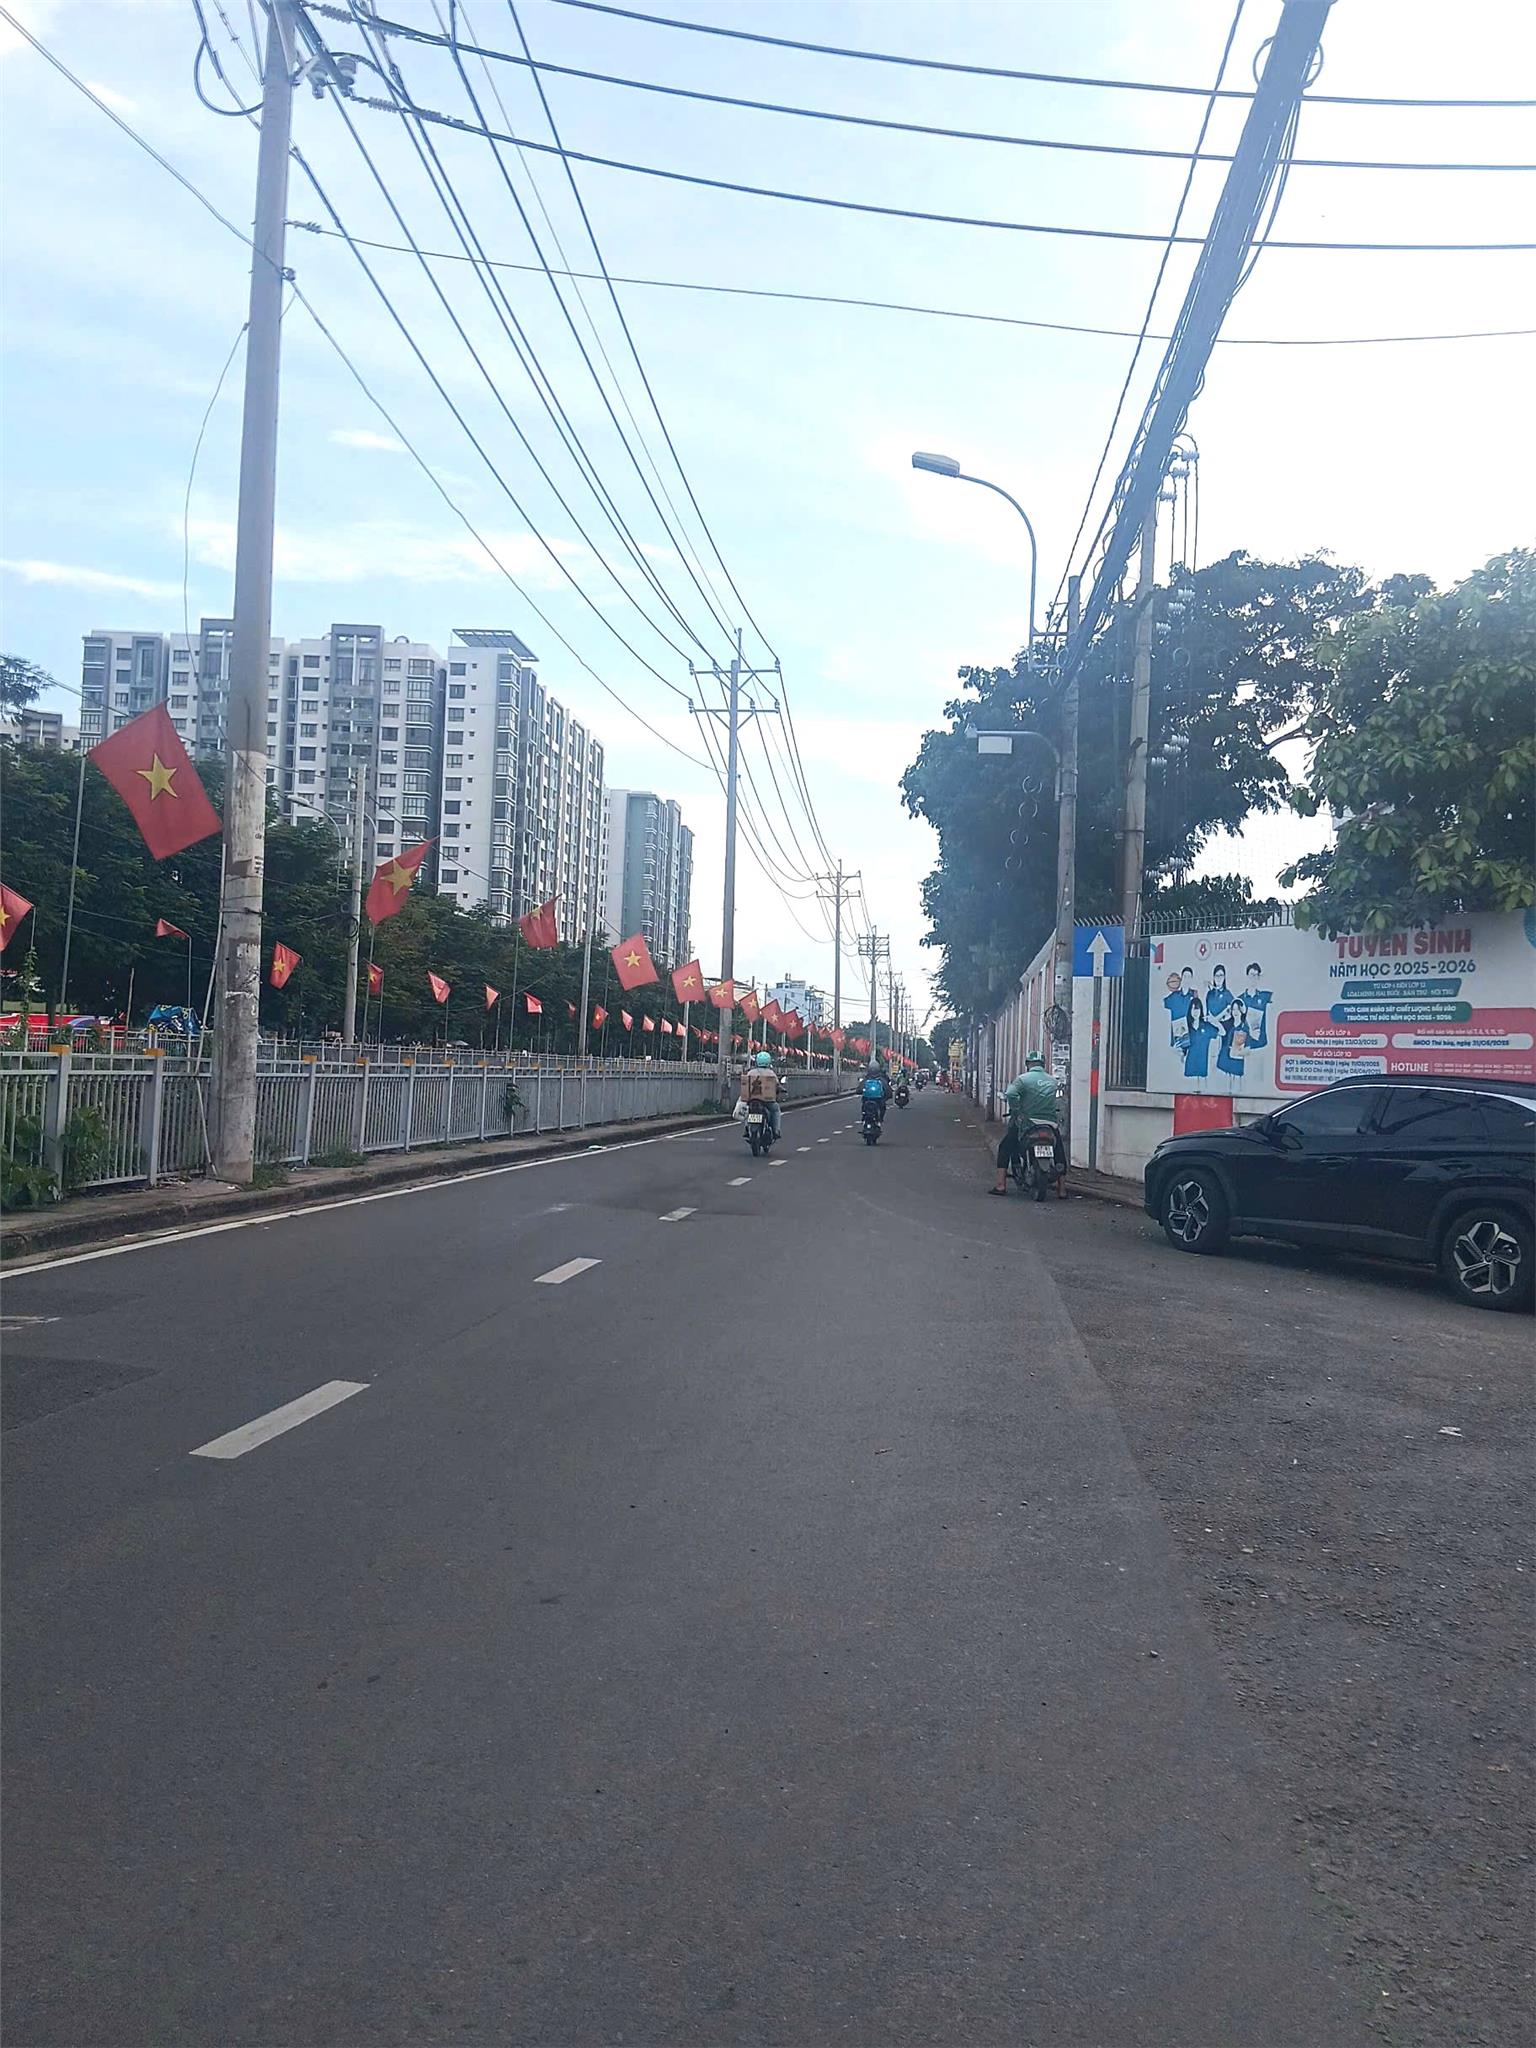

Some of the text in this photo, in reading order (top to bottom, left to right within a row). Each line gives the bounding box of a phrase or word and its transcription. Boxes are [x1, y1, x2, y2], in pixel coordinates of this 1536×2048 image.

[1414, 929, 1471, 954] SINH
[1329, 961, 1357, 978] NĂM
[1360, 963, 1391, 979] HỌC
[1390, 1062, 1429, 1073] HOTLINE
